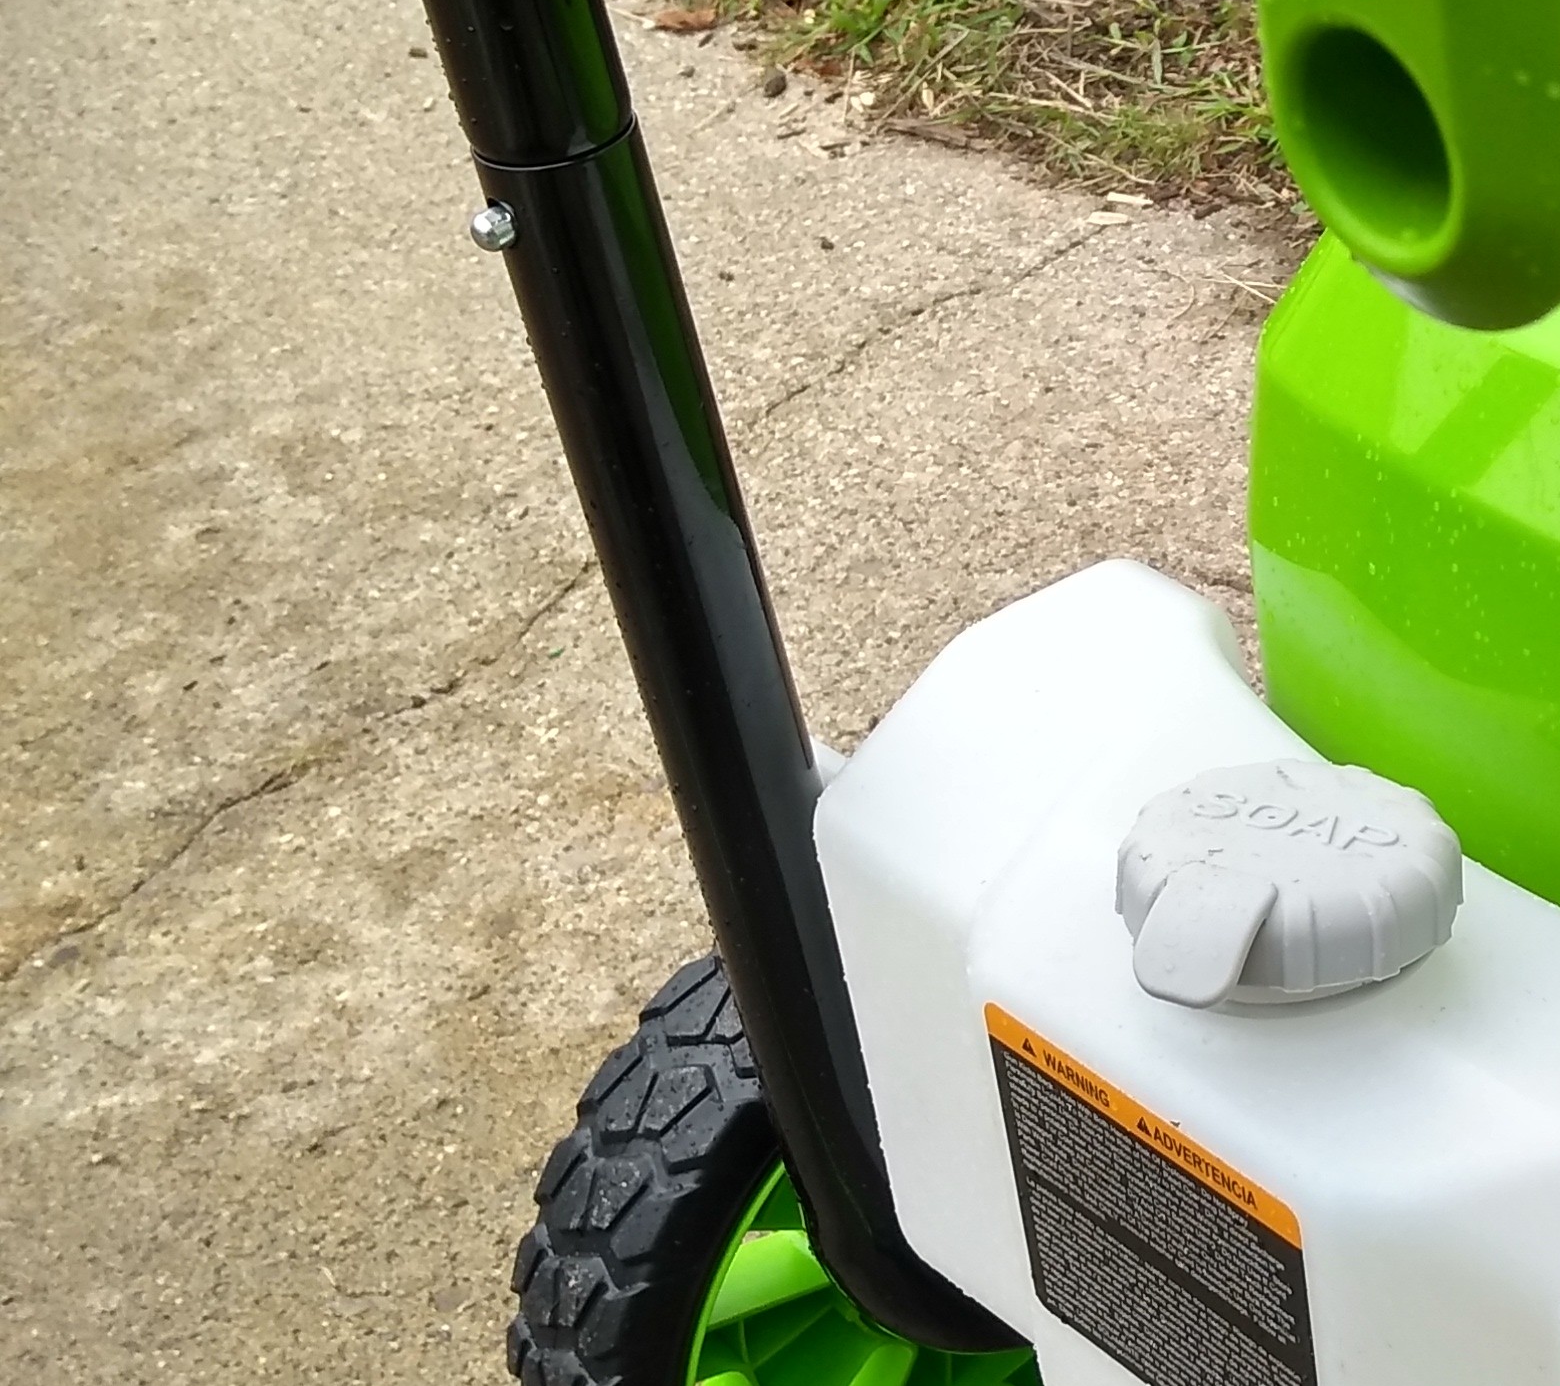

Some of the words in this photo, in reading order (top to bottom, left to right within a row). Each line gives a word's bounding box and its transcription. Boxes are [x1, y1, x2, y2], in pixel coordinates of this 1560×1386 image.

[1192, 792, 1400, 851] SOAP
[1043, 1049, 1110, 1109] WARNING
[1153, 1126, 1258, 1210] ADVERTENCIA
